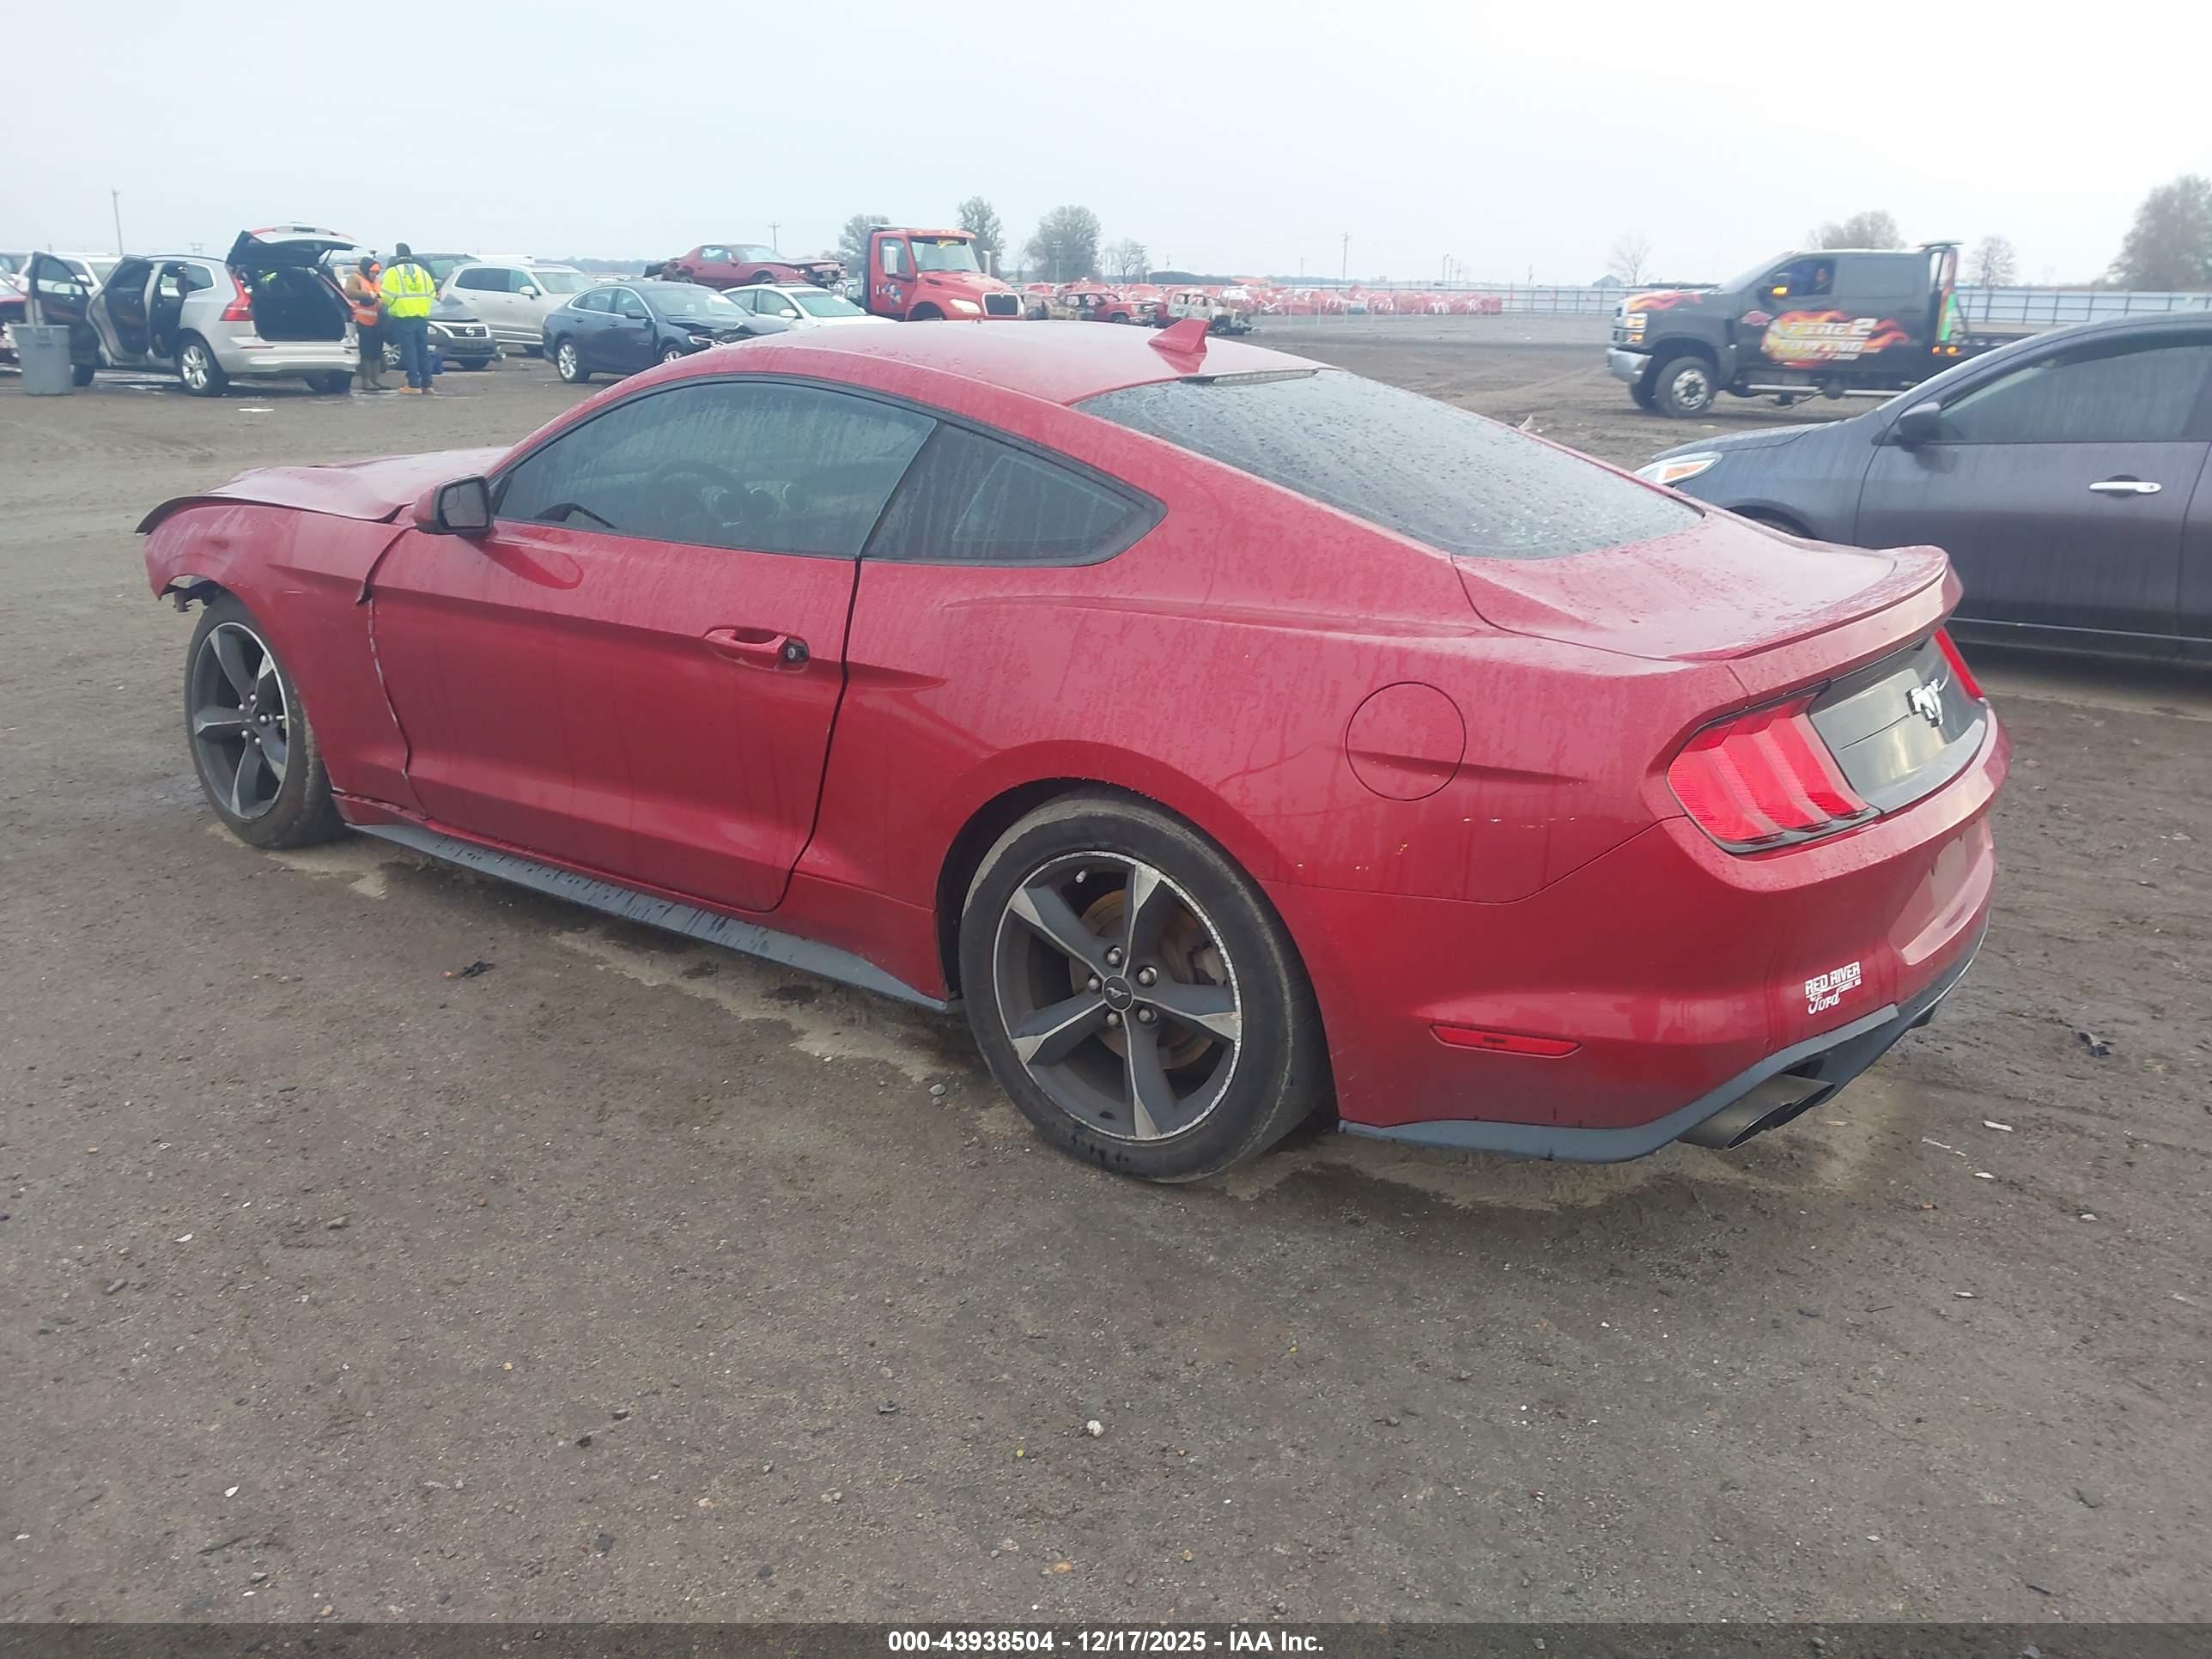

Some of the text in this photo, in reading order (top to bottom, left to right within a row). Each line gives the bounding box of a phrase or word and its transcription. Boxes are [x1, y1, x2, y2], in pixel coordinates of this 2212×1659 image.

[1850, 318, 1878, 336] 2
[1805, 974, 1828, 995] RED
[1829, 962, 1860, 986] RIVER
[1808, 988, 1840, 1015] Ford
